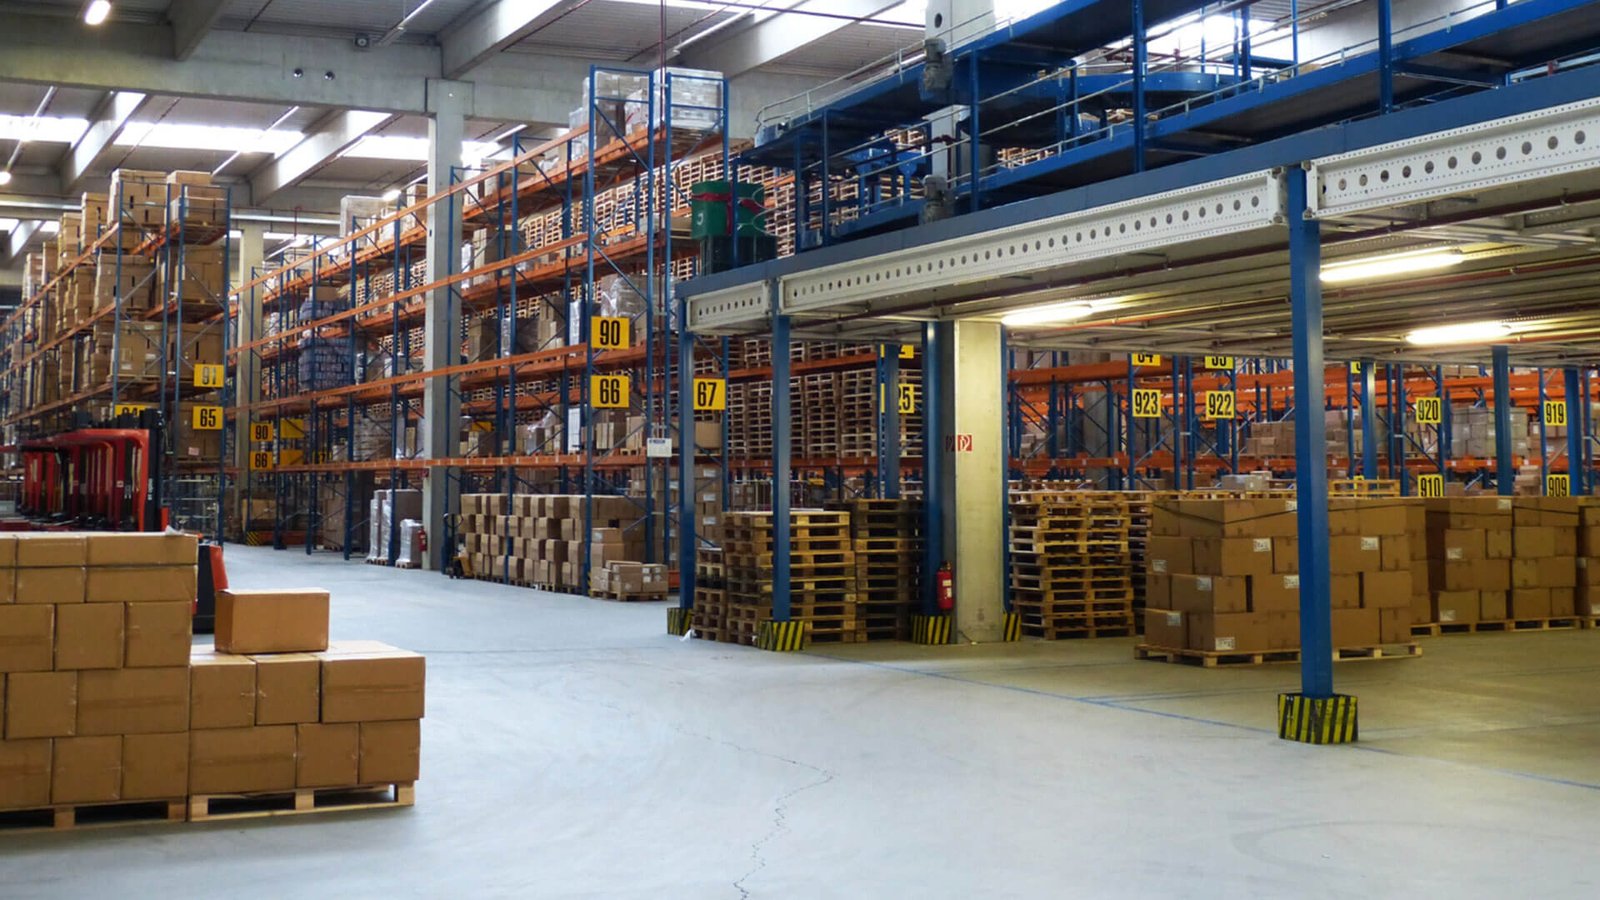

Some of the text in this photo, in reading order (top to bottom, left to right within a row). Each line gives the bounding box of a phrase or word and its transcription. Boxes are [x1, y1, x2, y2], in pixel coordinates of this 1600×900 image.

[600, 320, 620, 346] 90
[202, 367, 216, 385] 91
[600, 378, 620, 404] 66
[697, 381, 717, 407] 67
[1135, 391, 1158, 415] 923
[1208, 393, 1232, 416] 922
[1417, 399, 1438, 421] 920
[1545, 403, 1564, 424] 919
[200, 408, 216, 427] 65
[255, 425, 269, 440] 90
[1420, 477, 1440, 497] 910
[1548, 477, 1567, 497] 909
